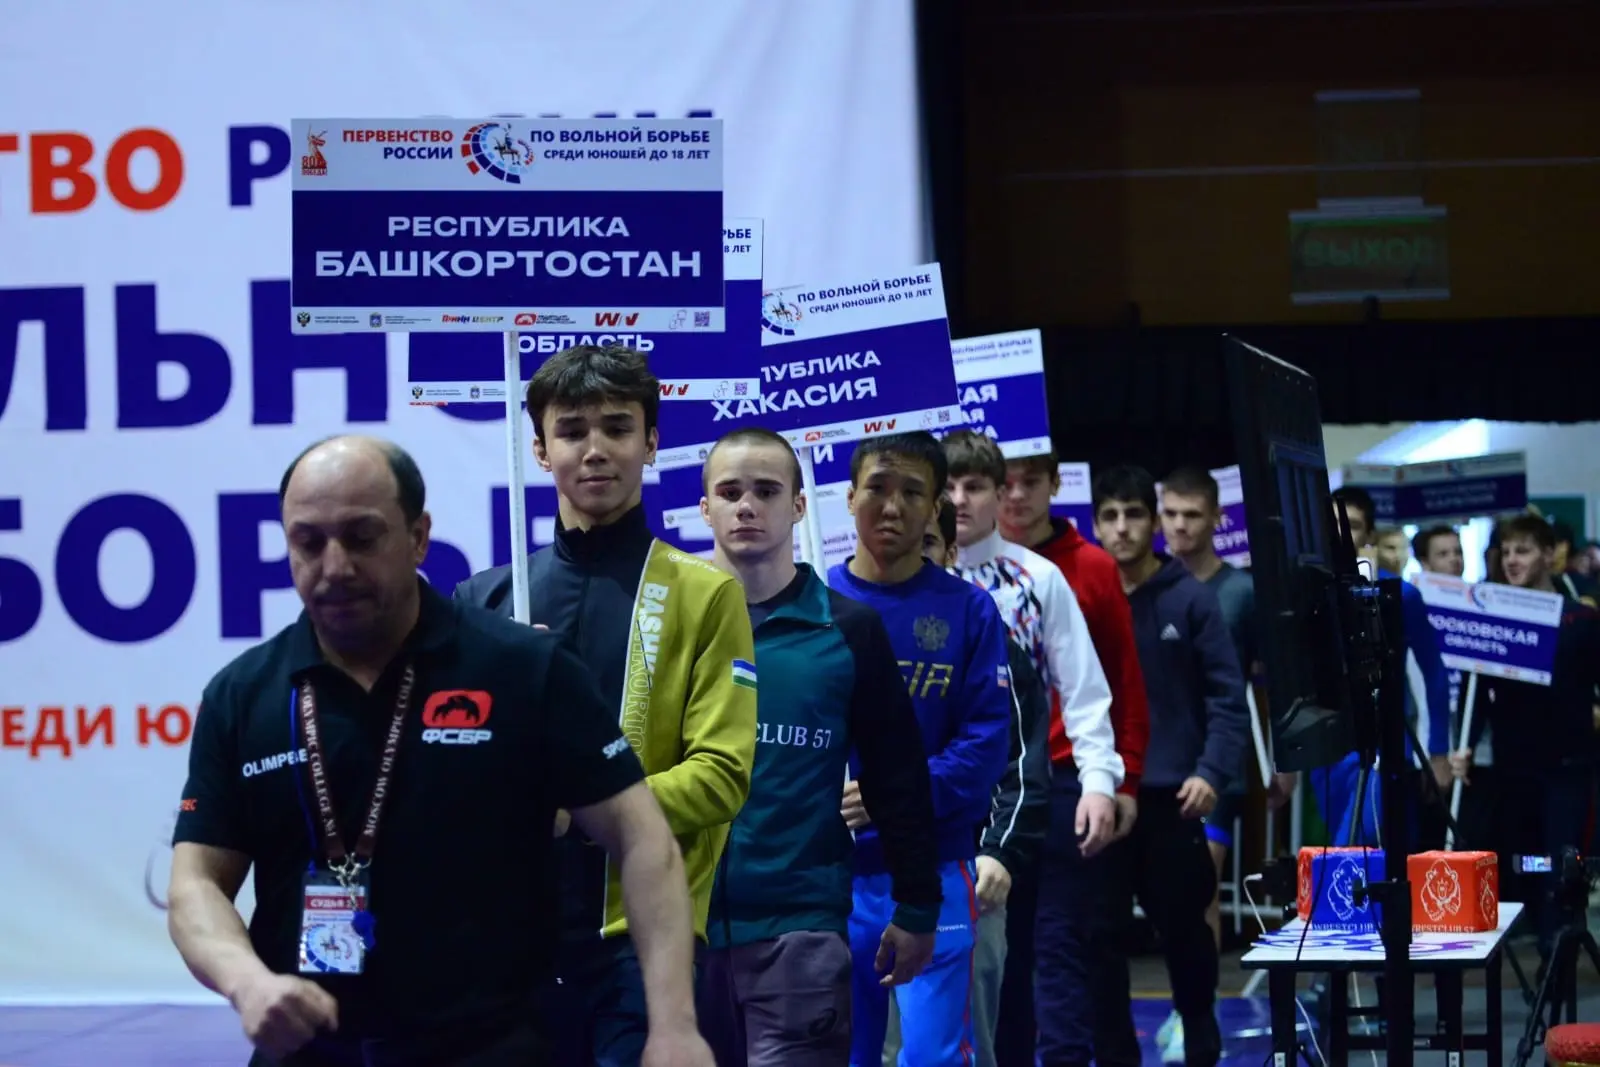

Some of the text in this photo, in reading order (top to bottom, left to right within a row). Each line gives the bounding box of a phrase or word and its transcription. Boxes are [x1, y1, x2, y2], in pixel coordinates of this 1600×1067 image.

[342, 130, 453, 143] ПЕРВЕНСТВО
[530, 126, 711, 143] ПО ВОЛЬНОЙ БОРЬБЕ
[383, 146, 453, 160] РОССИИ
[543, 146, 711, 161] СРЕДИ ЮНОШЕЙ ДО 18 ЛЕТ
[387, 215, 630, 238] РЕСПУБЛИКА
[732, 244, 752, 253] ЛЕТ
[315, 250, 701, 278] БАШКОРТОСТАН
[797, 273, 932, 304] ПО ВОЛЬНОЙ БОРЬБЕ
[809, 287, 933, 315] СРЕДИ ЮНОШЕЙ ДО 18 ЛЕТ
[711, 376, 878, 422] ХАКАСИЯ
[421, 729, 493, 745] ФСБР
[812, 728, 832, 749] 57
[363, 776, 389, 837] MOSCOW
[380, 712, 405, 773] OLYMPIC
